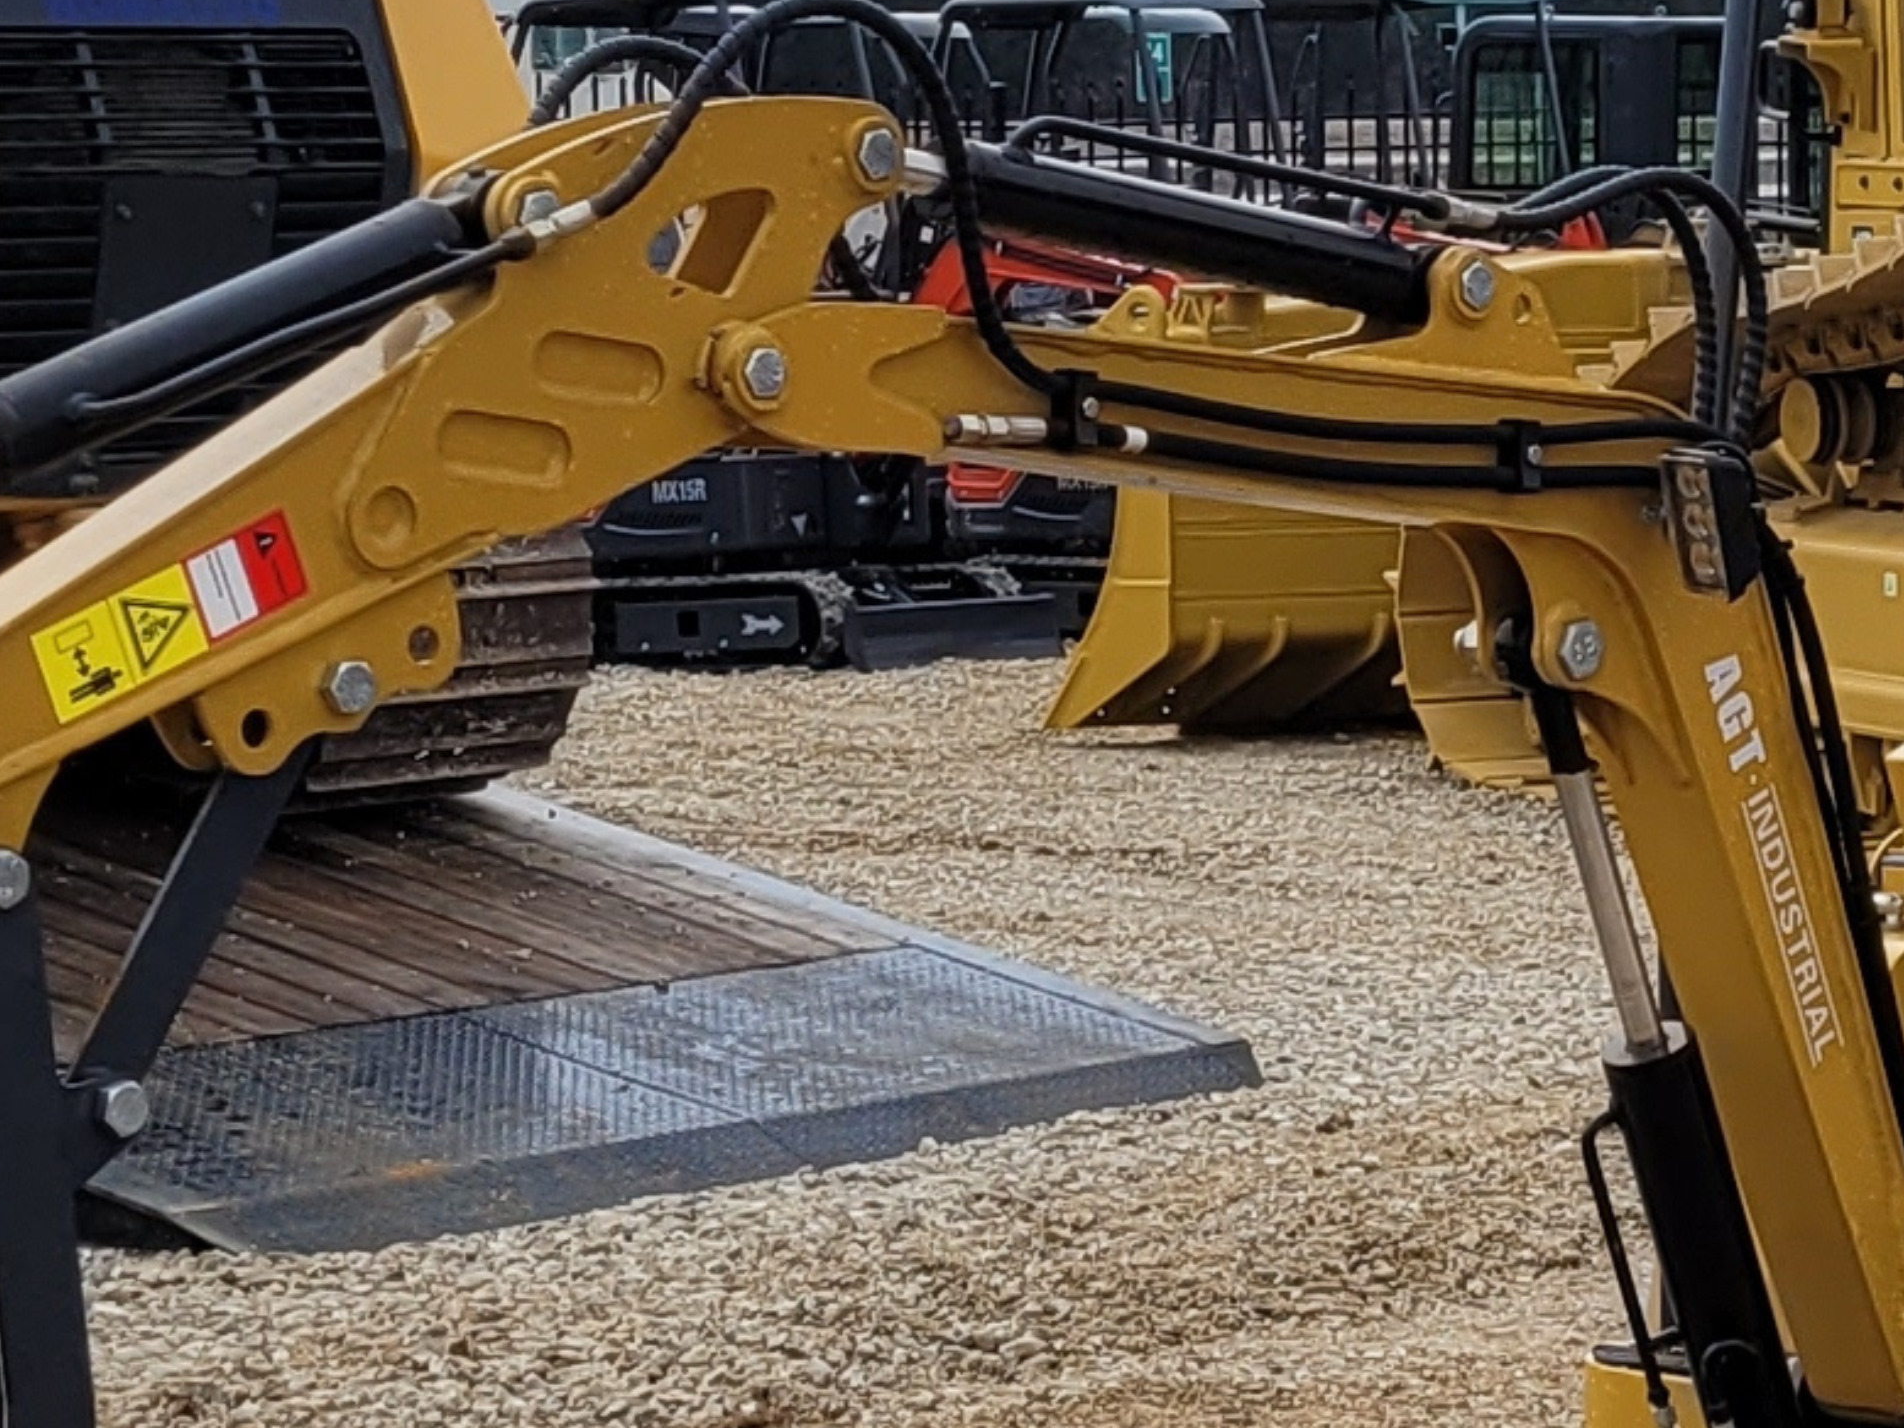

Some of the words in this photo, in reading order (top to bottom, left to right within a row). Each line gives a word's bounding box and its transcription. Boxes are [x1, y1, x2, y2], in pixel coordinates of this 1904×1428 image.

[651, 477, 708, 504] MX15R
[1703, 653, 1768, 773] AGT
[1747, 784, 1841, 1066] INDUSTRIAL
